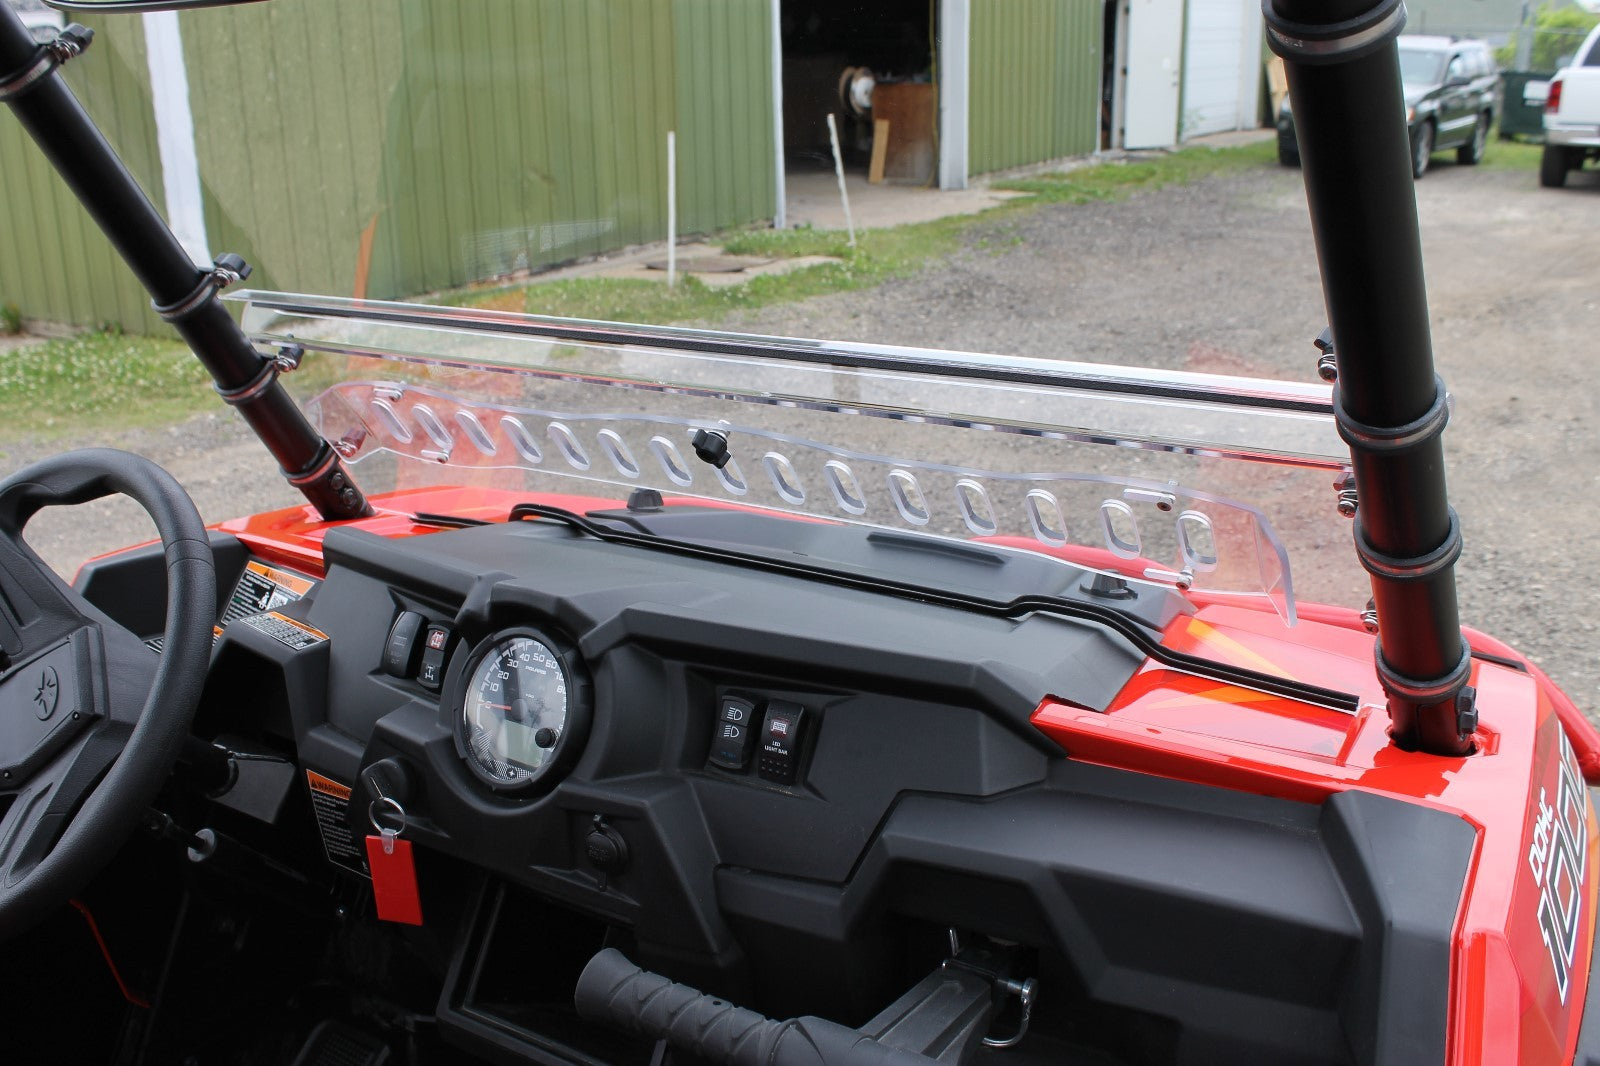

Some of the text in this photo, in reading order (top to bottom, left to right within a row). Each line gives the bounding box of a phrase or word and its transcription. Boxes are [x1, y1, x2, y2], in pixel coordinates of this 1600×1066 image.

[519, 653, 530, 662] 40
[533, 653, 545, 663] 50
[507, 658, 519, 668] 30
[545, 659, 558, 670] 60
[497, 670, 509, 680] 20
[490, 682, 499, 692] 10
[317, 780, 351, 798] WARNING
